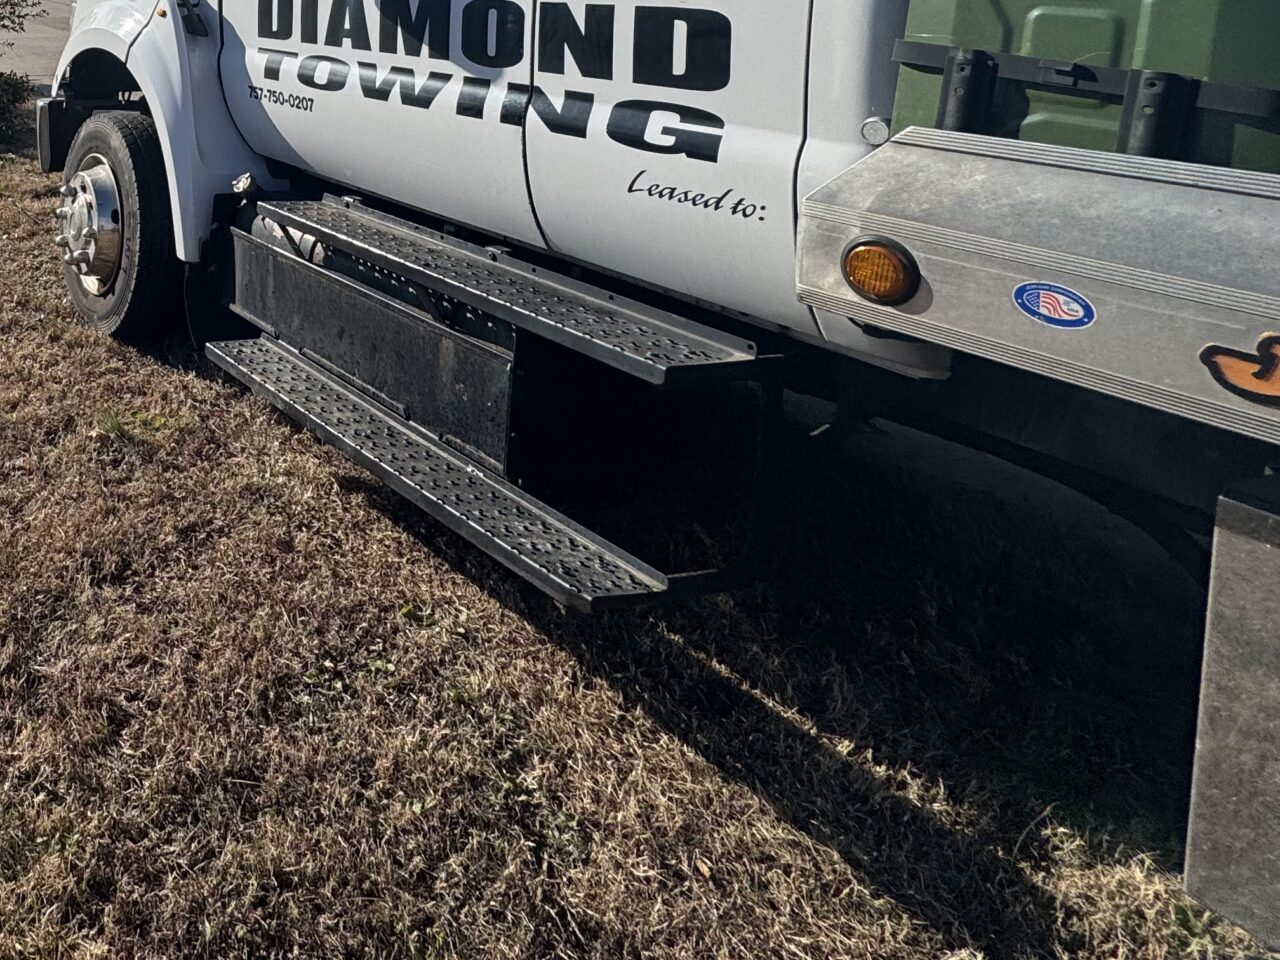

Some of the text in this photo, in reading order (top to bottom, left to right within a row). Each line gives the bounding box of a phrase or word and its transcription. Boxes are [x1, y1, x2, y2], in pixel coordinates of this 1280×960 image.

[247, 85, 315, 113] 757-750-0207
[255, 47, 726, 163] TOWING
[627, 169, 766, 221] Leased to:
